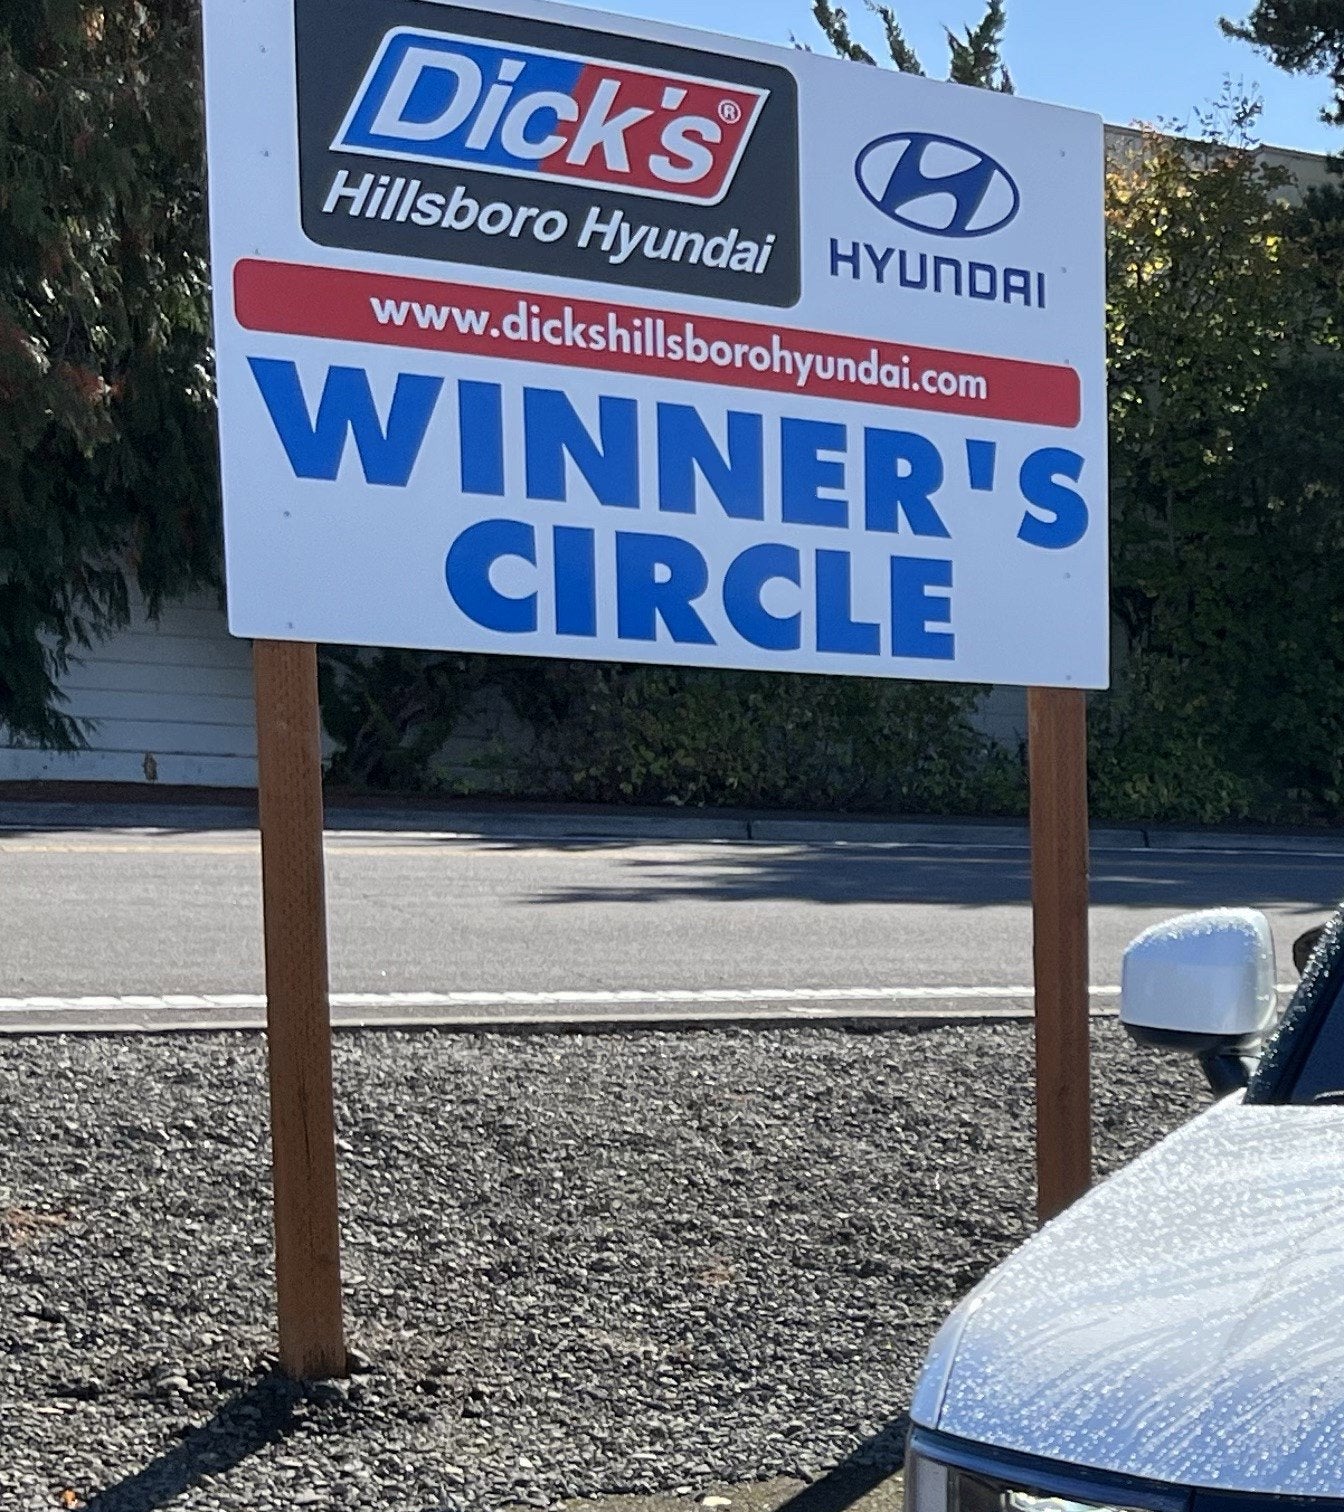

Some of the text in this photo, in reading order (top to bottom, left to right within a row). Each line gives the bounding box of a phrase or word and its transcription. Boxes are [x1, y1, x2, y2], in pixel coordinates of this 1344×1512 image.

[368, 46, 722, 184] Dick's
[321, 169, 776, 274] Hillsboro Hyundai
[829, 237, 1046, 309] HYUNDAI
[370, 293, 988, 401] www.dickshillsborohyundai.com
[246, 355, 1090, 551] WINNER'S
[445, 517, 956, 661] CIRCLE
